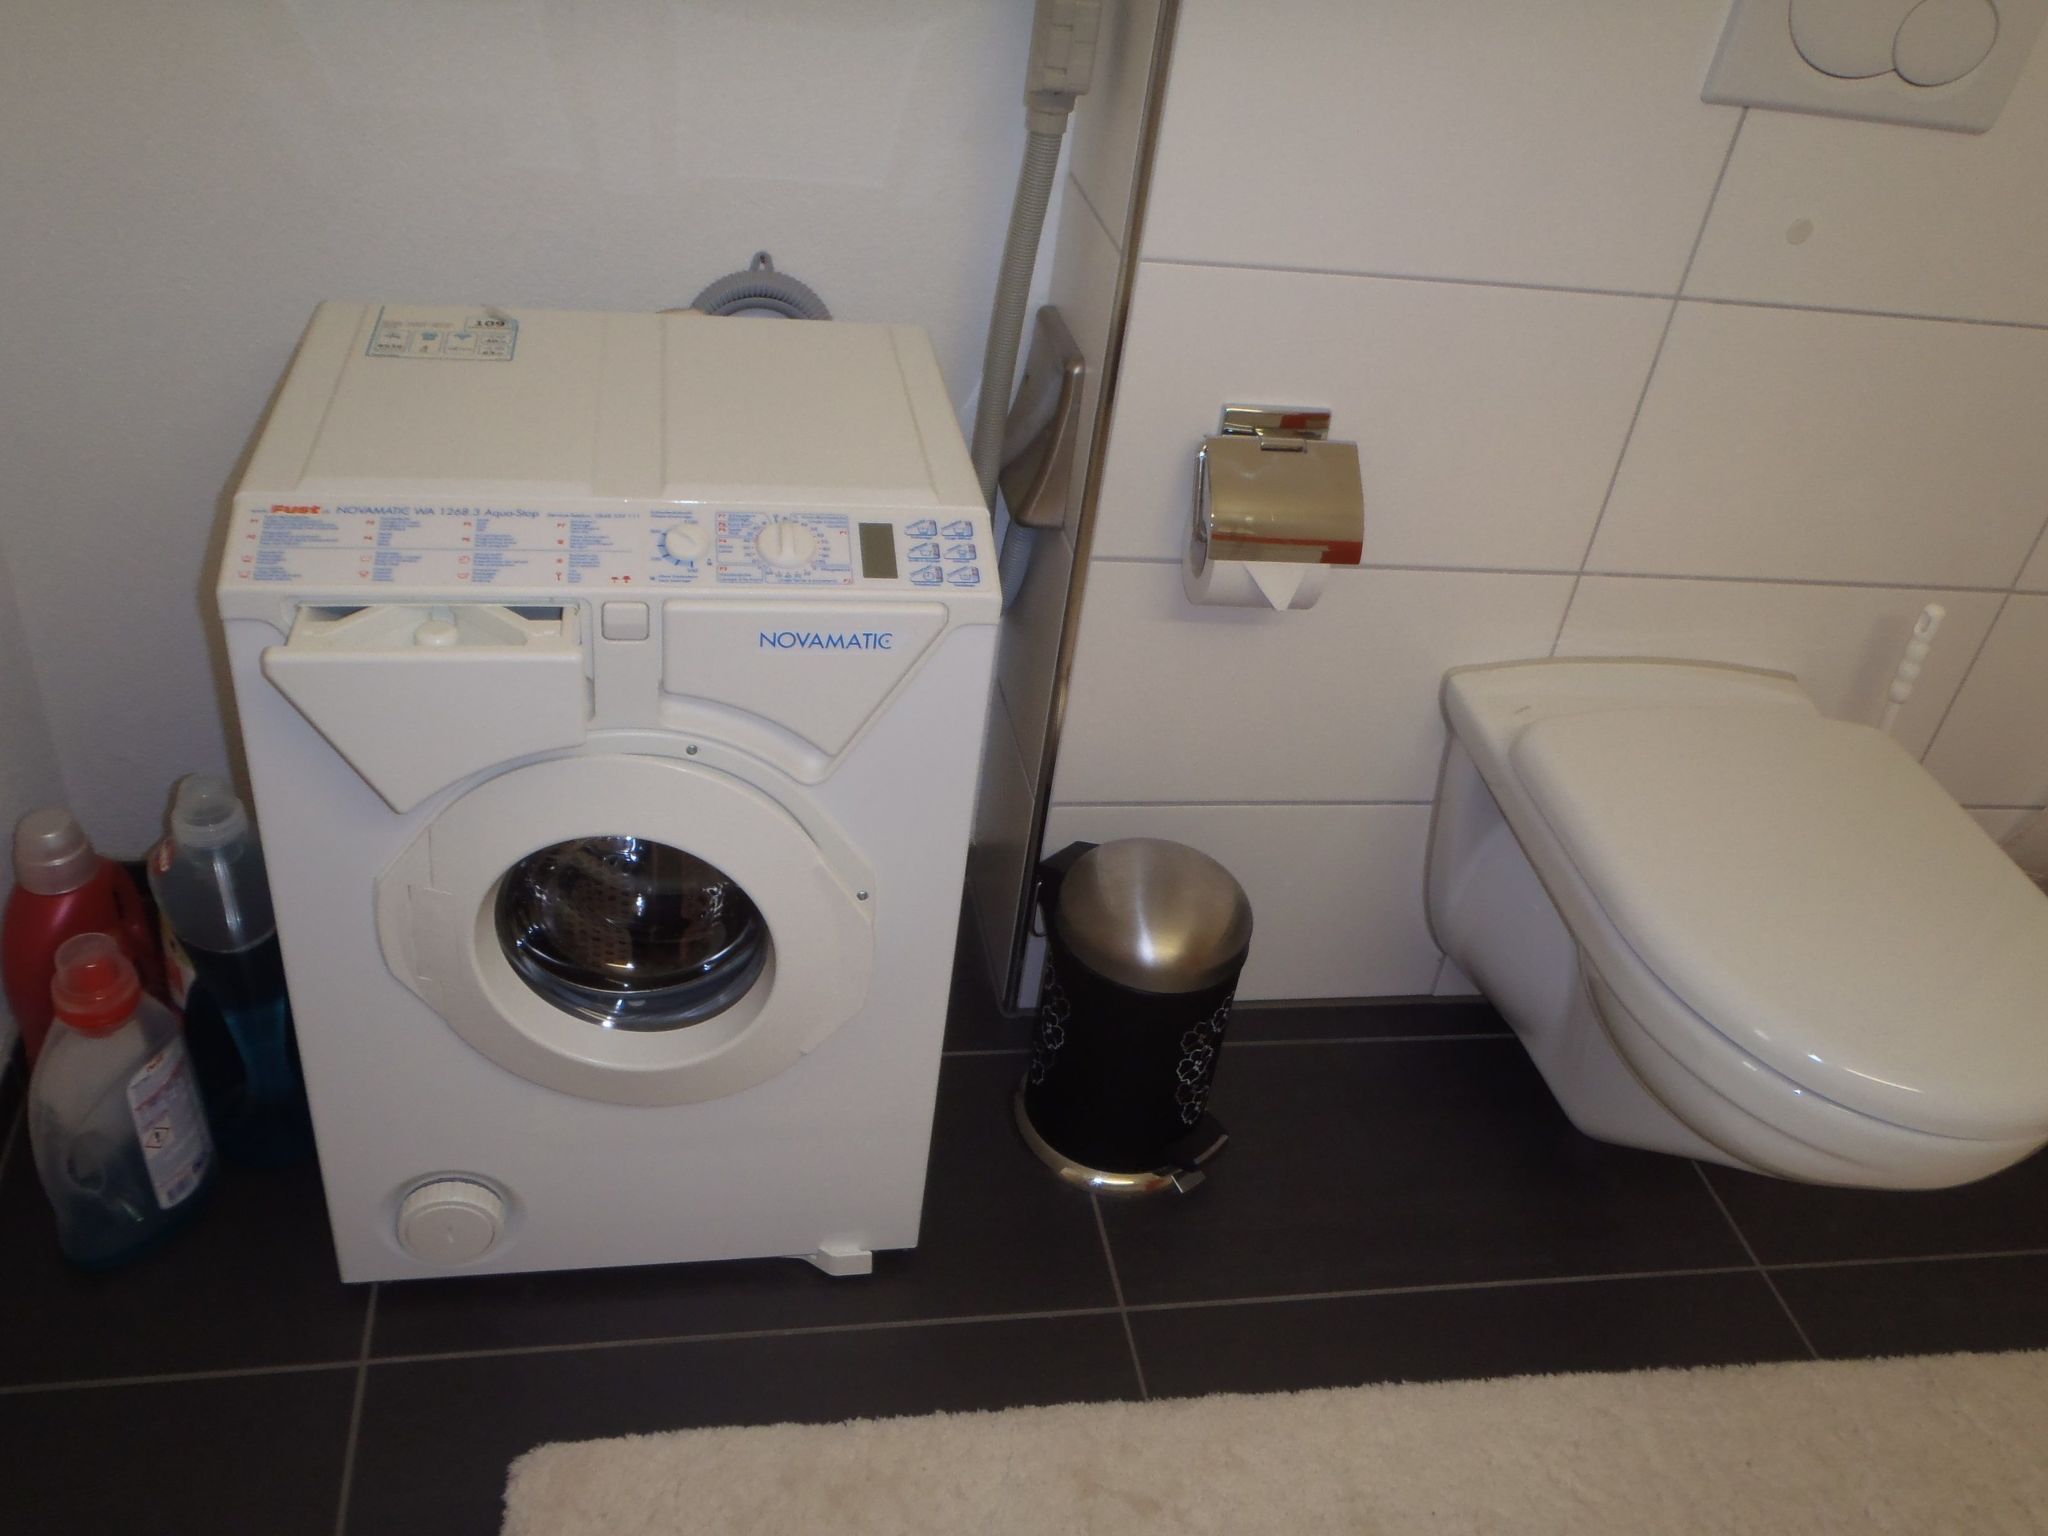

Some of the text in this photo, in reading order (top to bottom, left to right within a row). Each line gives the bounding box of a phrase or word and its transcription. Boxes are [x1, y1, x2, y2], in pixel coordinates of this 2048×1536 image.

[336, 506, 410, 516] NOVAMATIC
[414, 507, 435, 516] WA
[759, 631, 893, 650] NOVAMATIC
